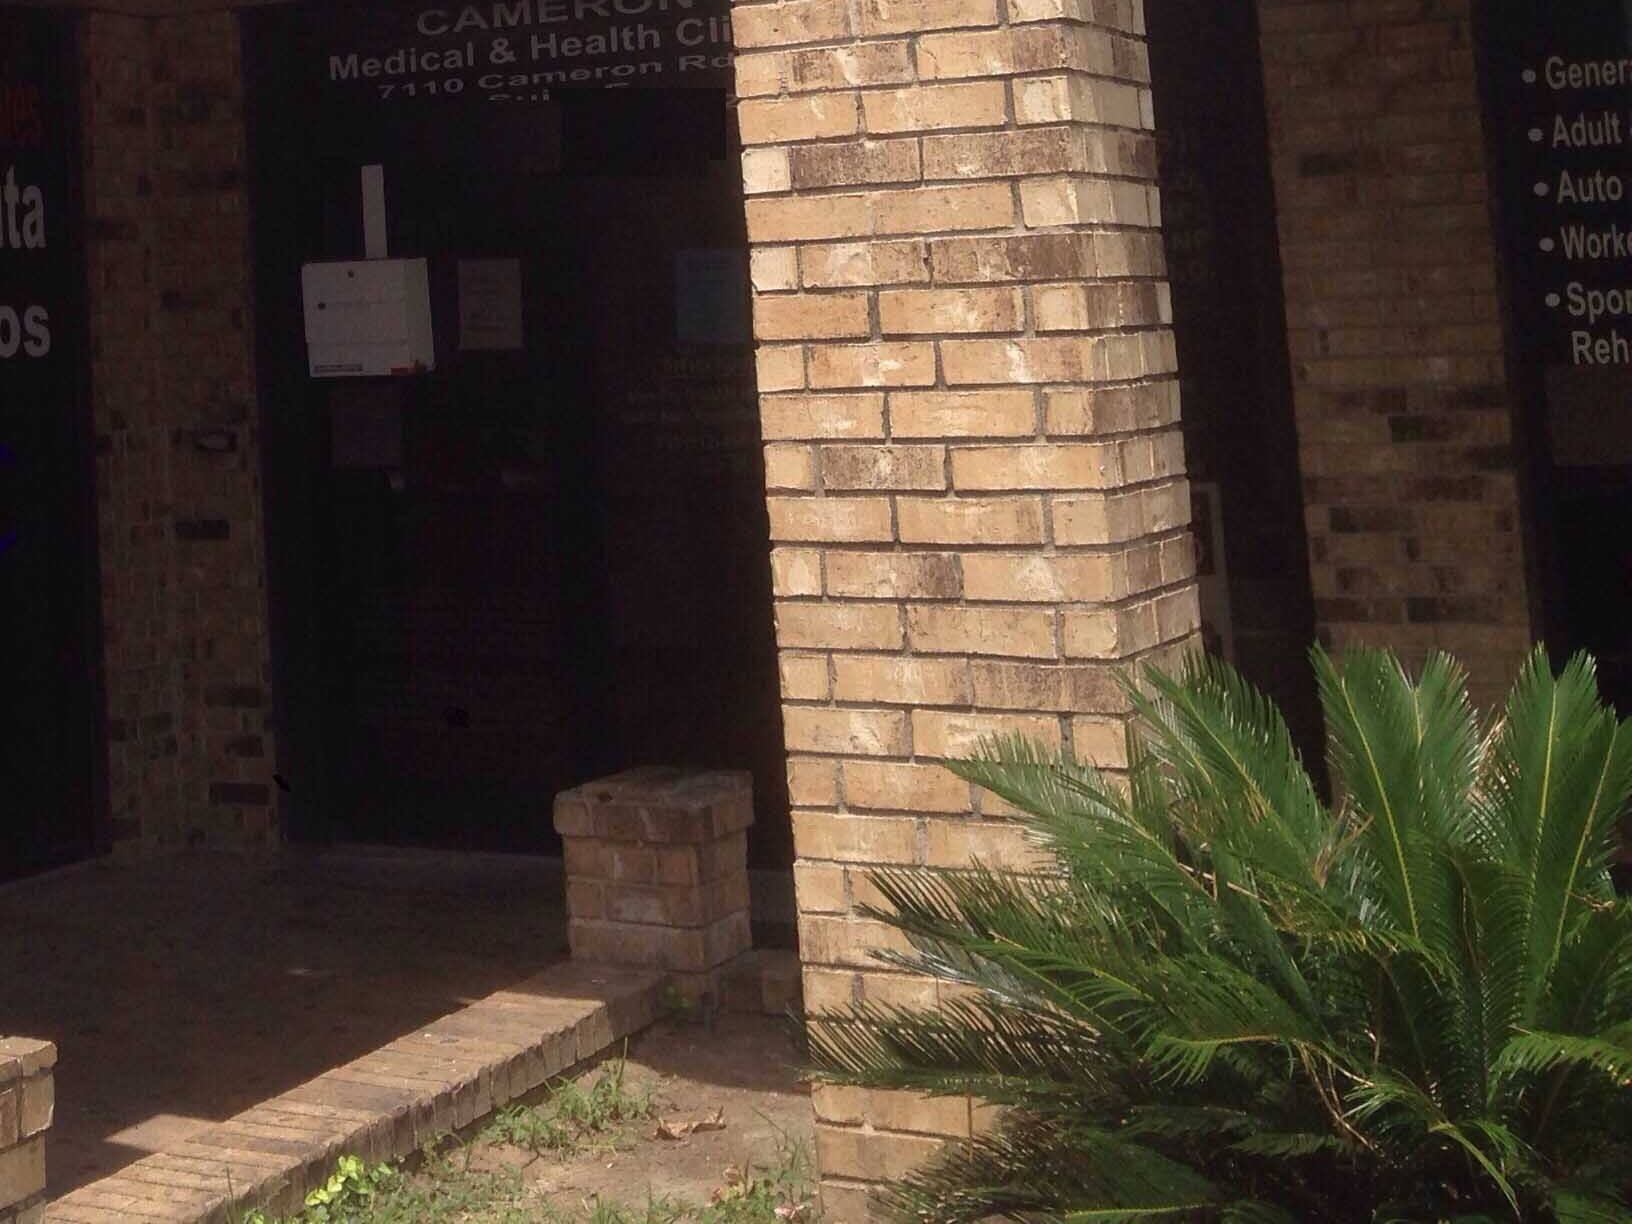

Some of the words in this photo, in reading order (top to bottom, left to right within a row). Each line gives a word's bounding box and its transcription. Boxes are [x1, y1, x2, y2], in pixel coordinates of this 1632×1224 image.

[329, 42, 474, 82] Medical
[488, 38, 517, 65] &
[531, 20, 660, 60] Health
[378, 78, 464, 100] 7110
[478, 60, 662, 91] Cameron
[1545, 56, 1632, 89] Gener
[1552, 112, 1623, 149] Adult
[1557, 169, 1623, 204] Auto
